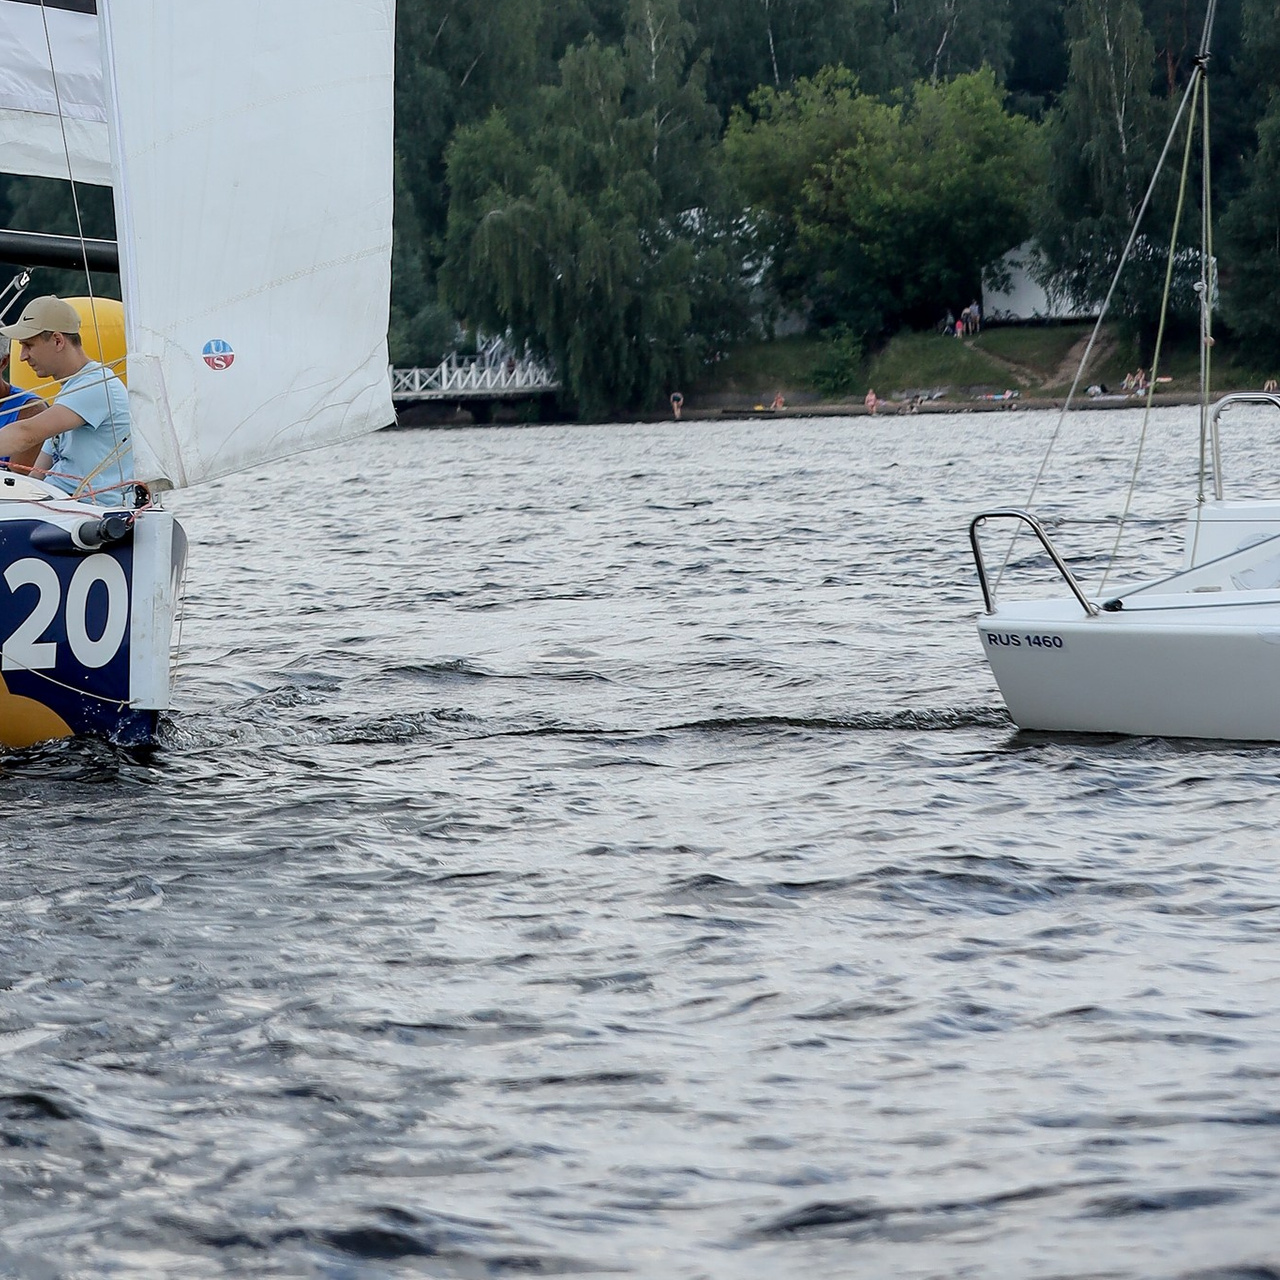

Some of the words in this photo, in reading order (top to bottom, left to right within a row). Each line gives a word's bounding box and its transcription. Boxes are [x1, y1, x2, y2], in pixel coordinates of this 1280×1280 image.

[1, 552, 129, 672] 20
[986, 632, 1021, 647] RUS
[1025, 634, 1063, 649] 1460
